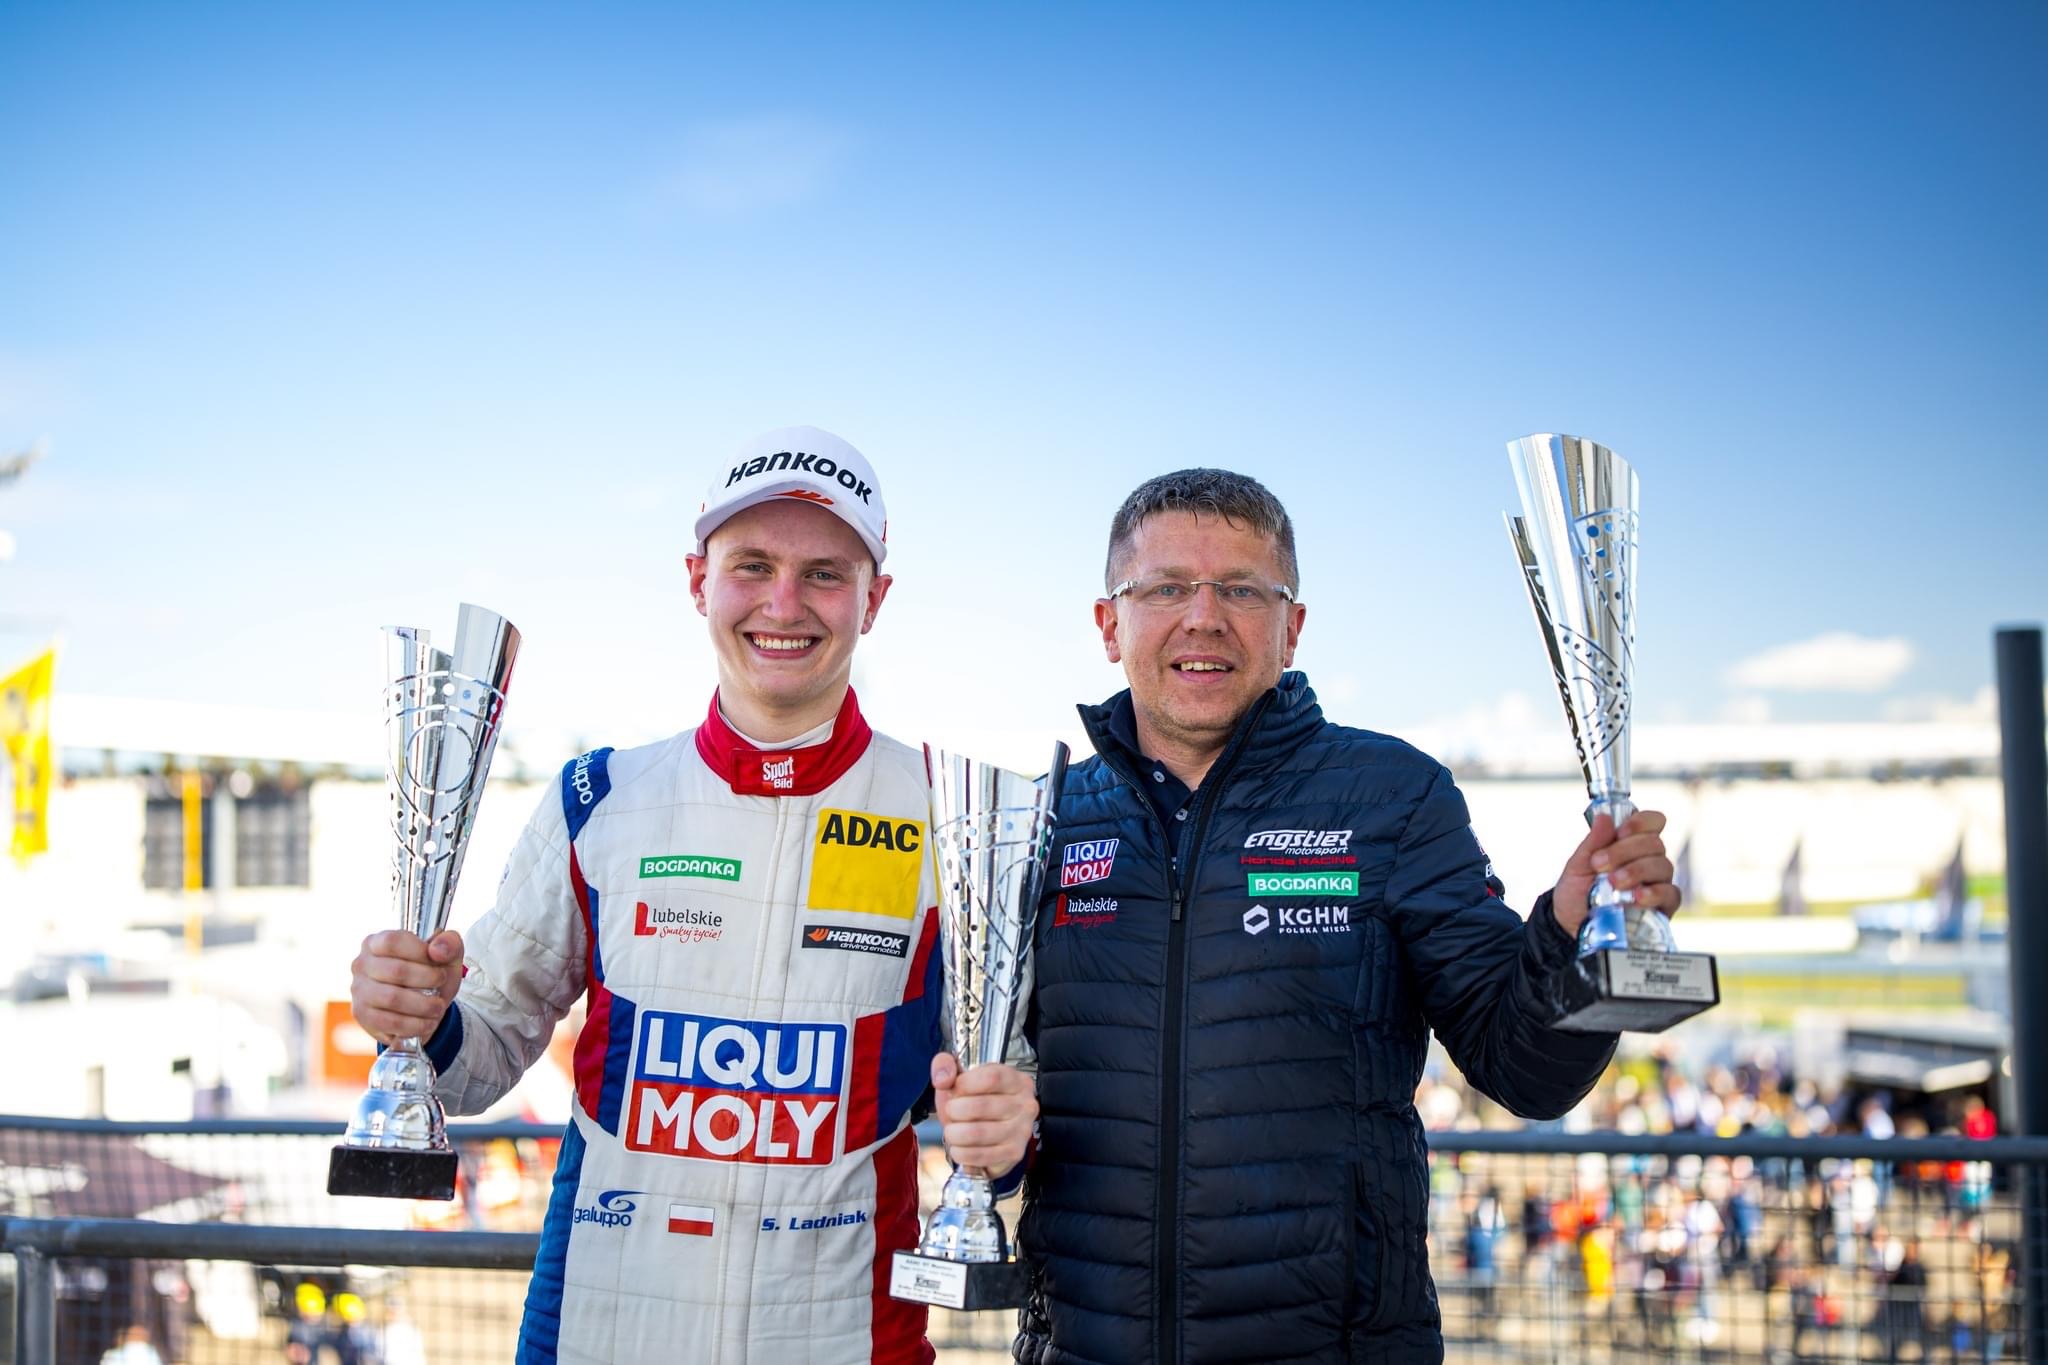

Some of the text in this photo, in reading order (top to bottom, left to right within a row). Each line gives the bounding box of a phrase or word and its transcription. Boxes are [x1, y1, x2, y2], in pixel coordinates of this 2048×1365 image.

[762, 756, 794, 781] Sport
[773, 778, 793, 789] Bild
[820, 813, 920, 853] ADAC
[1066, 841, 1115, 864] LIQUI
[1284, 847, 1349, 856] motorsport
[644, 860, 736, 877] BOGDANKA
[1063, 860, 1112, 885] MOLY
[1254, 877, 1353, 891] BOGDANKA
[1278, 906, 1349, 926] KGHM
[840, 942, 901, 956] driving emotion
[644, 1017, 836, 1090] LIQUI
[636, 1087, 837, 1159] MOLY
[573, 1206, 632, 1228] galuppo
[761, 1210, 866, 1231] S. Ladniak
